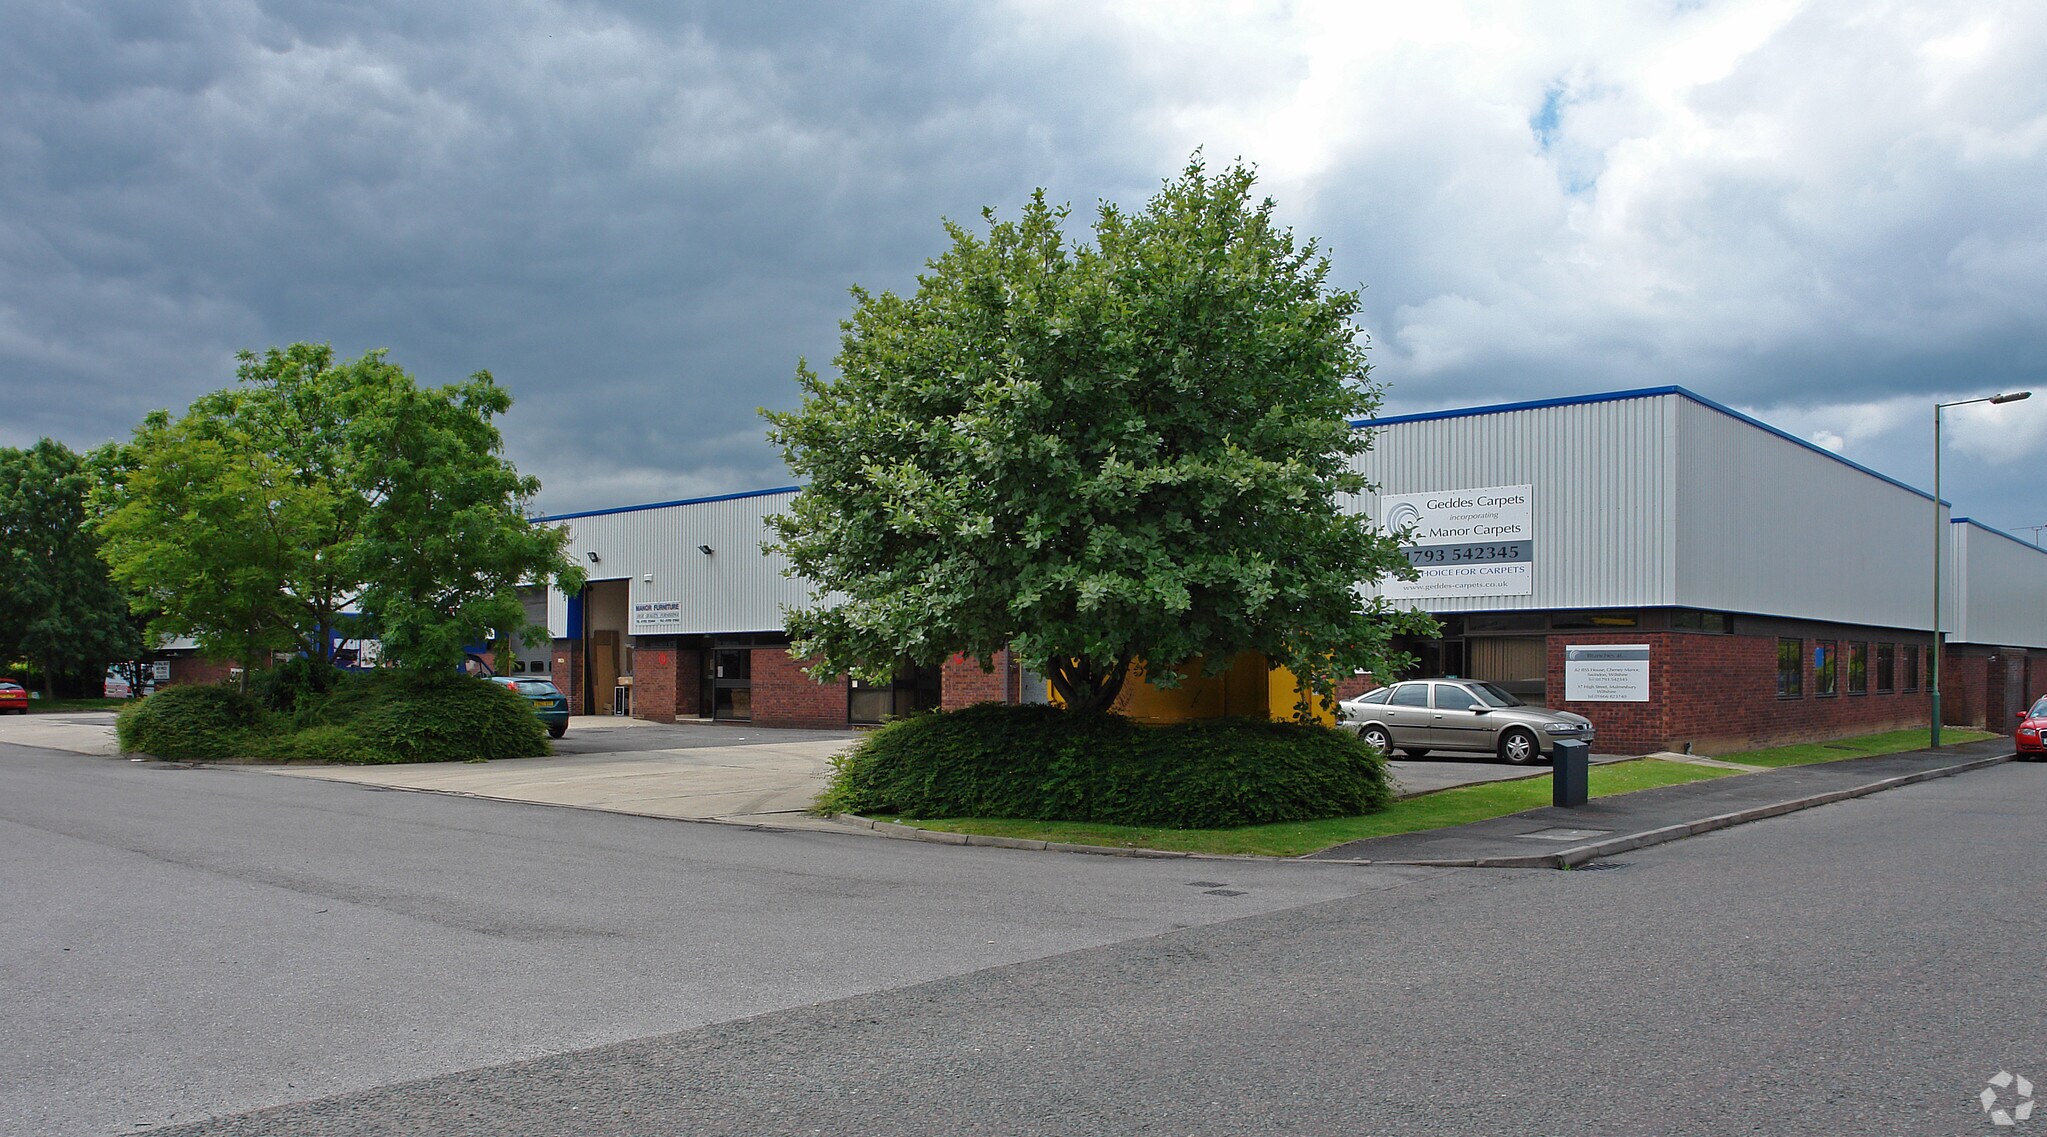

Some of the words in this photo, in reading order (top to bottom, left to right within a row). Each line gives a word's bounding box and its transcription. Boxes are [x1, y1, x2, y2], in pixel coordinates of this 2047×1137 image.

[1426, 497, 1473, 510] Geddes
[1477, 494, 1525, 508] Carpets
[1449, 511, 1499, 521] incorporating
[1429, 527, 1470, 538] Manor
[1473, 523, 1521, 537] Carpets
[1404, 549, 1445, 563] 1793
[1452, 546, 1519, 561] 542345
[1421, 568, 1454, 577] HOICE
[1455, 568, 1476, 576] FOR
[1479, 566, 1525, 575] CARPETS
[1403, 580, 1508, 592] www.geddes-carpets.co.uk
[654, 603, 679, 611] FURNITURE
